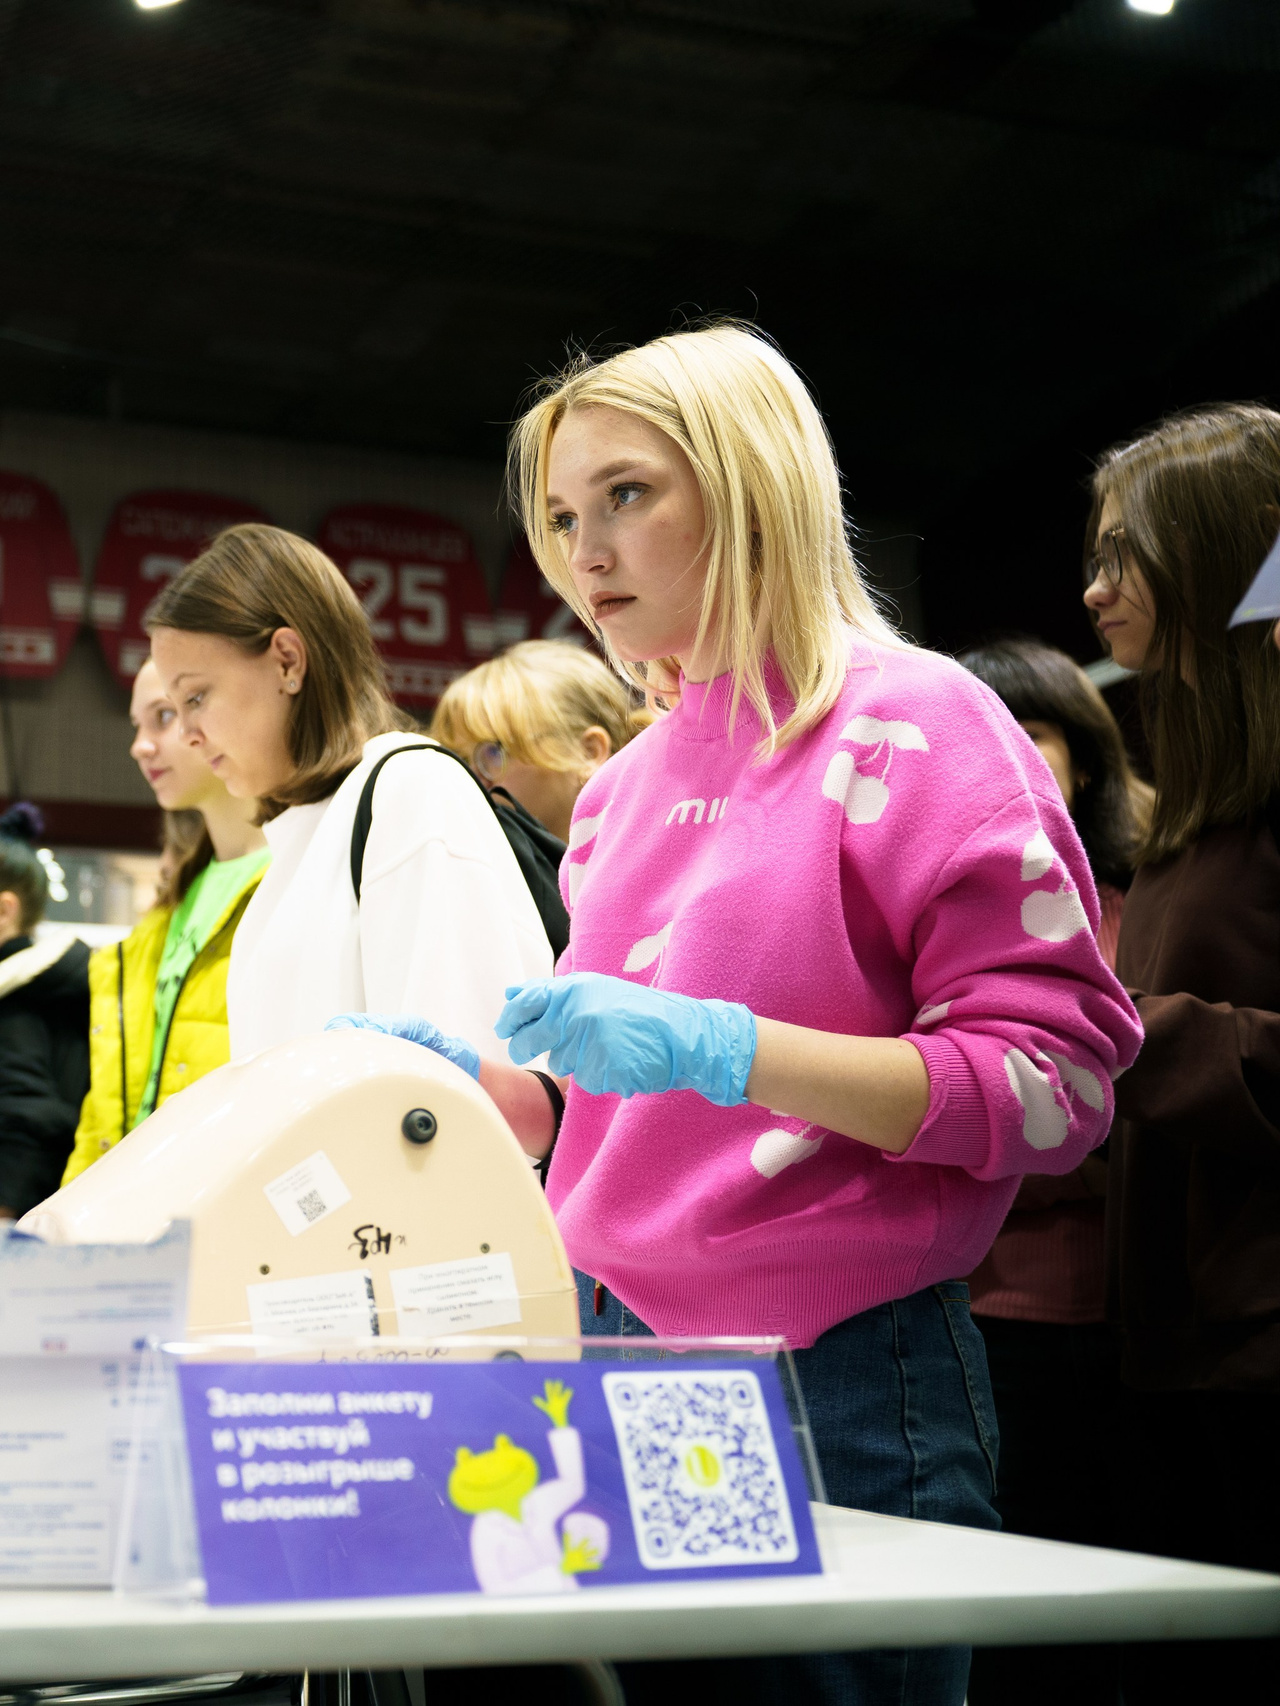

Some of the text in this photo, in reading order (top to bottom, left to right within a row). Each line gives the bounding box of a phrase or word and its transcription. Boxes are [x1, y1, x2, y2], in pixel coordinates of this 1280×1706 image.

[347, 557, 449, 646] 25
[206, 1386, 434, 1420] Заполни анкету
[211, 1417, 370, 1458] и участвуй
[216, 1457, 415, 1493] в розыгрыше
[221, 1487, 361, 1523] колонки!
